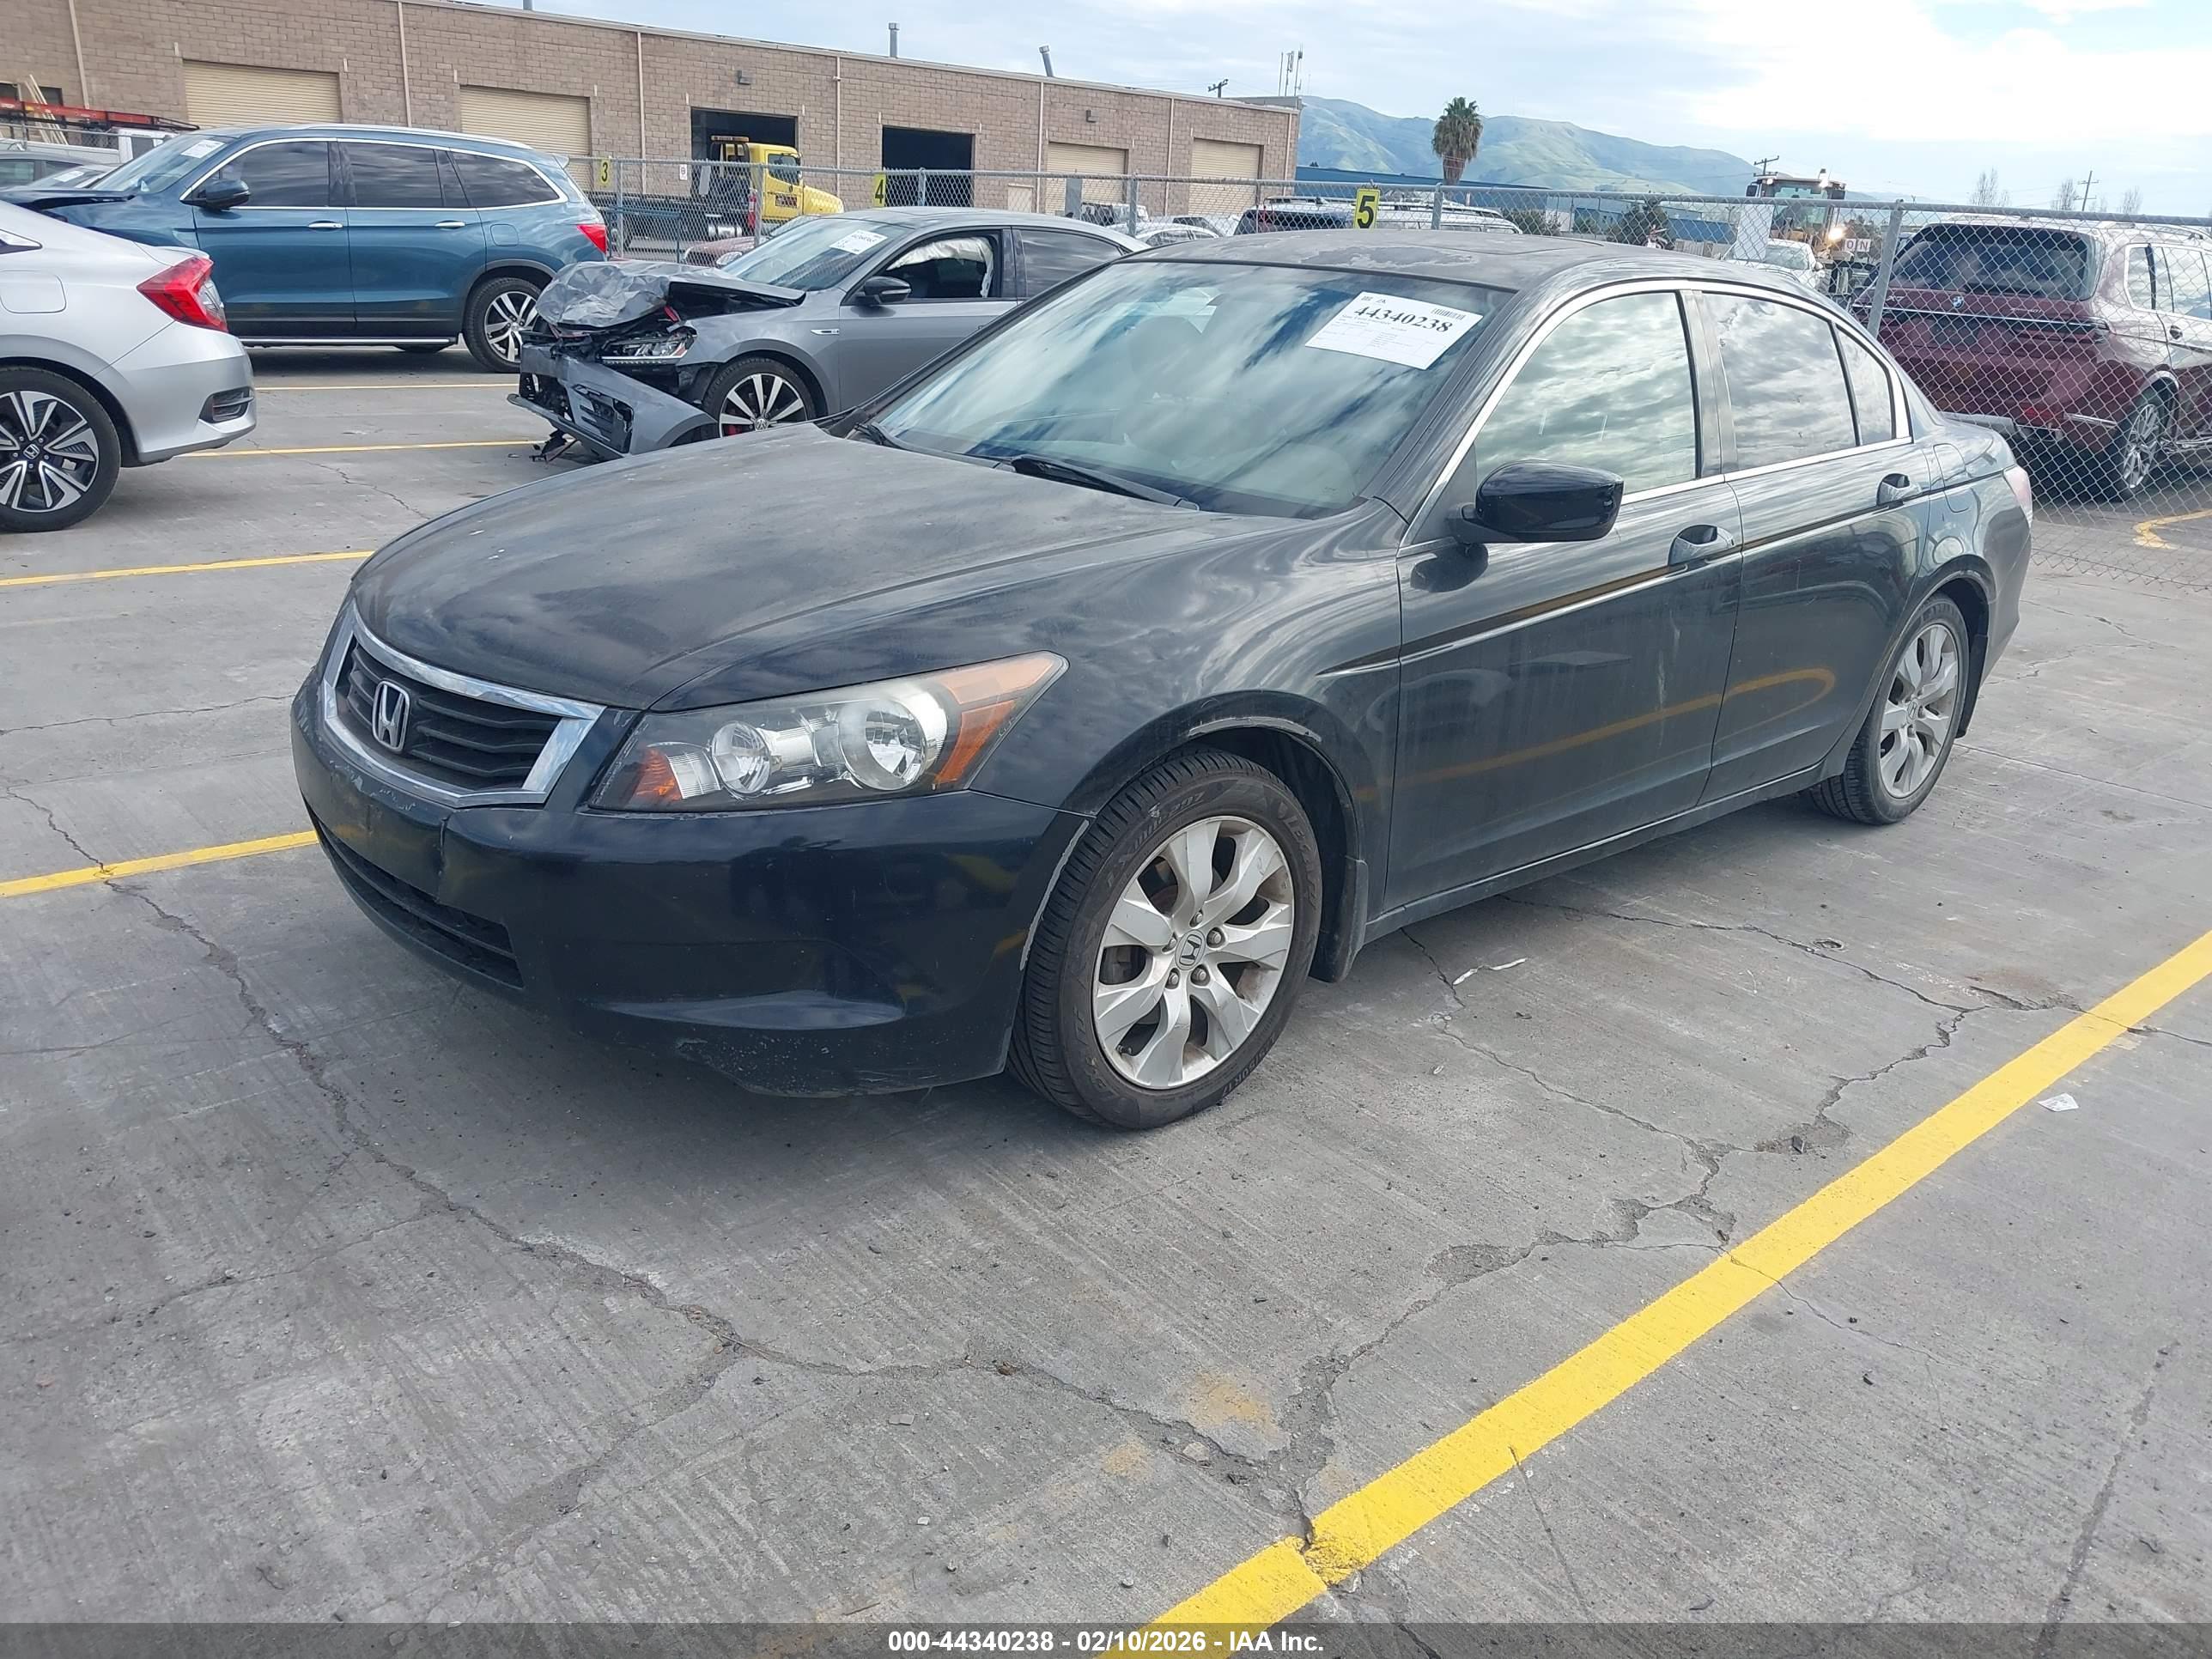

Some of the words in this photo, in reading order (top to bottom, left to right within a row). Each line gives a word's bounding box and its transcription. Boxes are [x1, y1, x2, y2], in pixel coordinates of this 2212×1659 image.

[601, 161, 609, 182] 3
[874, 179, 884, 204] 4
[1357, 195, 1376, 229] 5
[1354, 306, 1454, 332] 44340238
